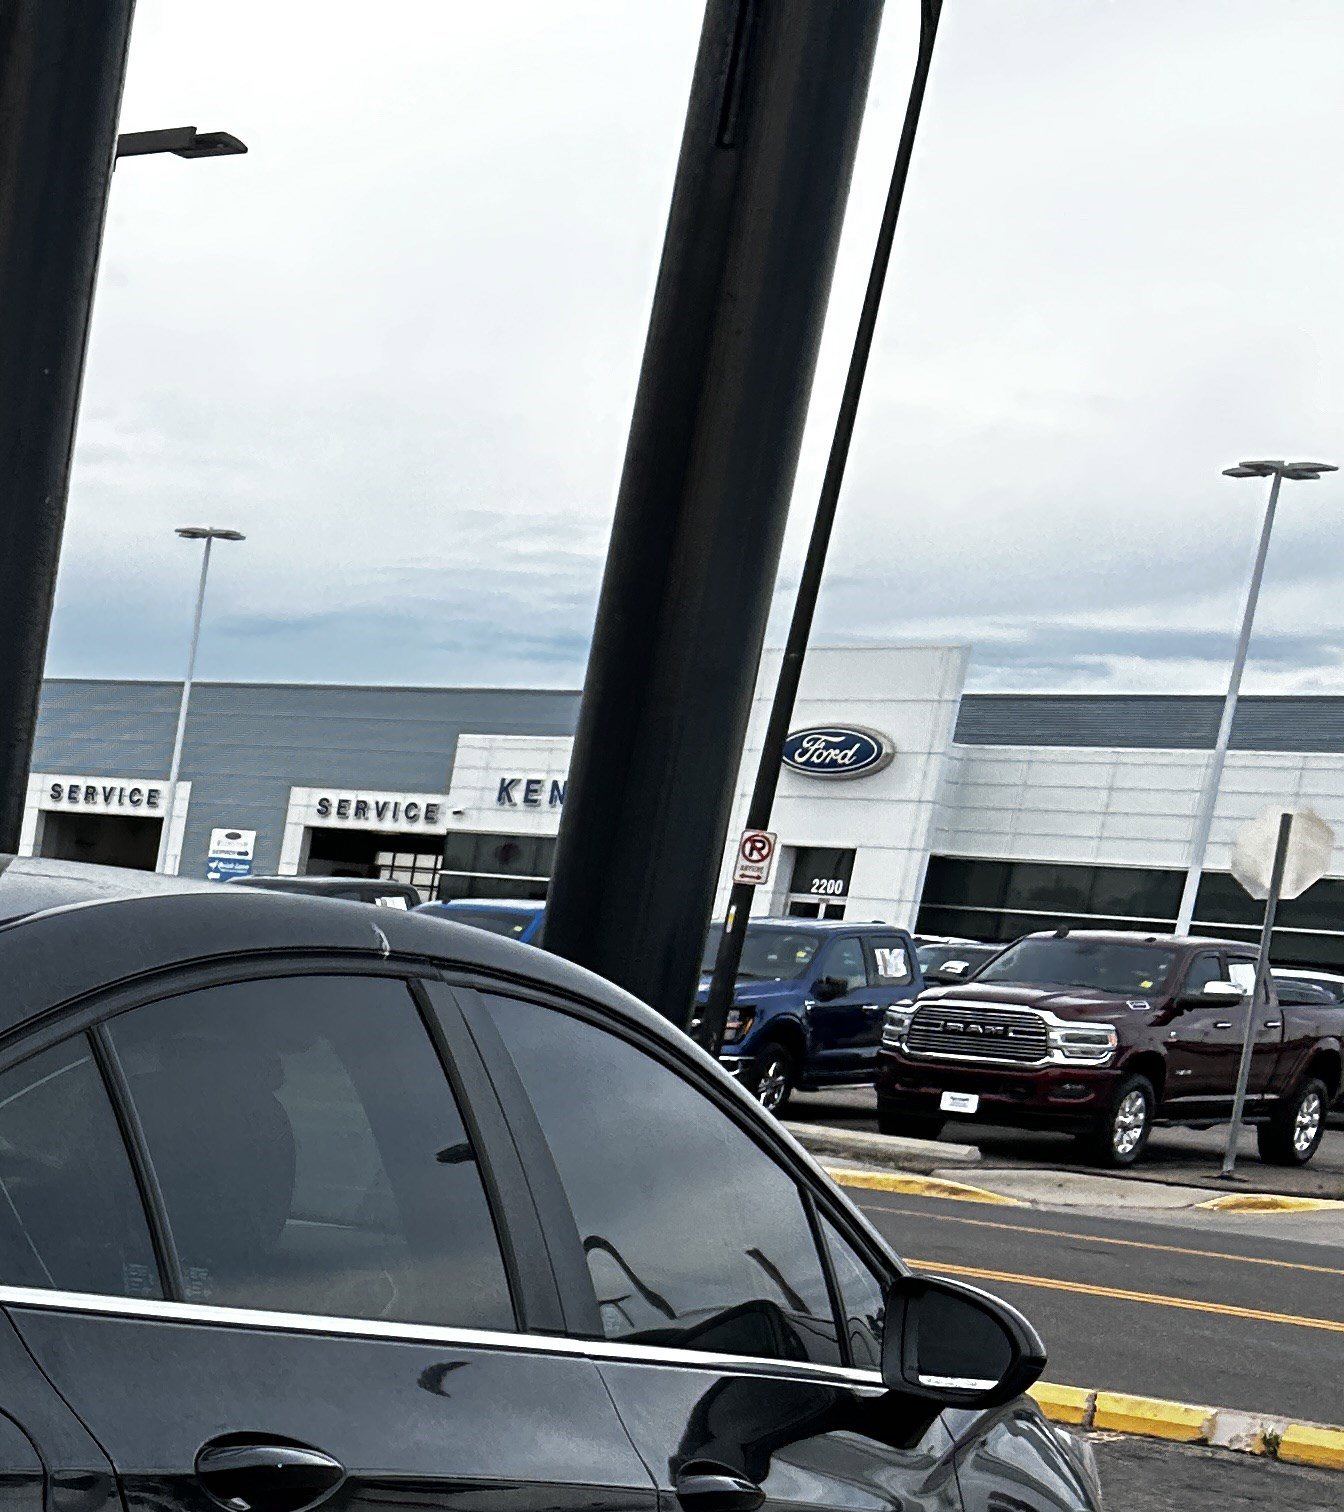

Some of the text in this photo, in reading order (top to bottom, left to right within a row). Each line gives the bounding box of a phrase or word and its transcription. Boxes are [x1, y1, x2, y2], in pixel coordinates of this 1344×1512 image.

[794, 734, 861, 765] Ford
[50, 782, 161, 808] SERVICE
[497, 777, 568, 807] KEN
[316, 797, 440, 824] SERVICE
[811, 878, 844, 895] 2200
[946, 1022, 1006, 1035] RAM
